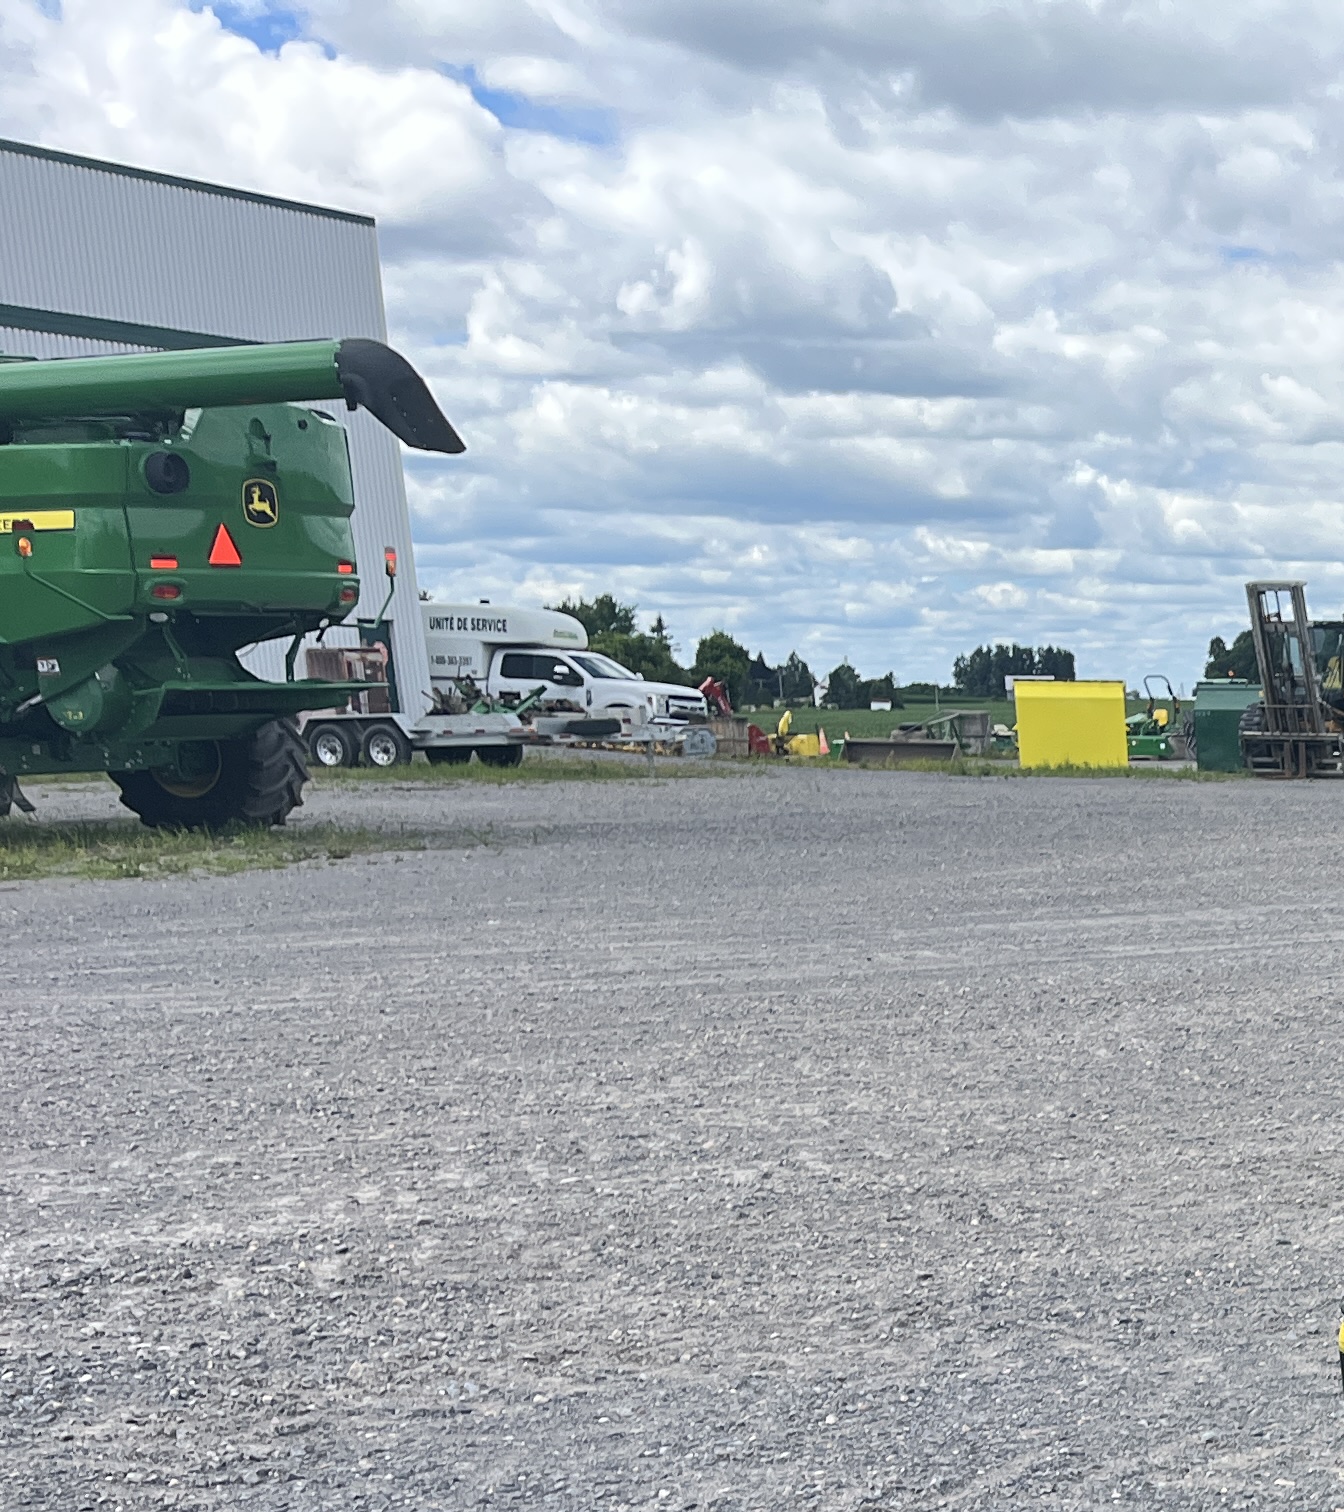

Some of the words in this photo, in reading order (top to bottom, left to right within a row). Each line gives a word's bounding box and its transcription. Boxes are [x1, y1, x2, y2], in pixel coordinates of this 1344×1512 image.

[429, 614, 454, 631] UNITÉ
[457, 617, 468, 632] DE
[471, 617, 507, 633] SERVICE
